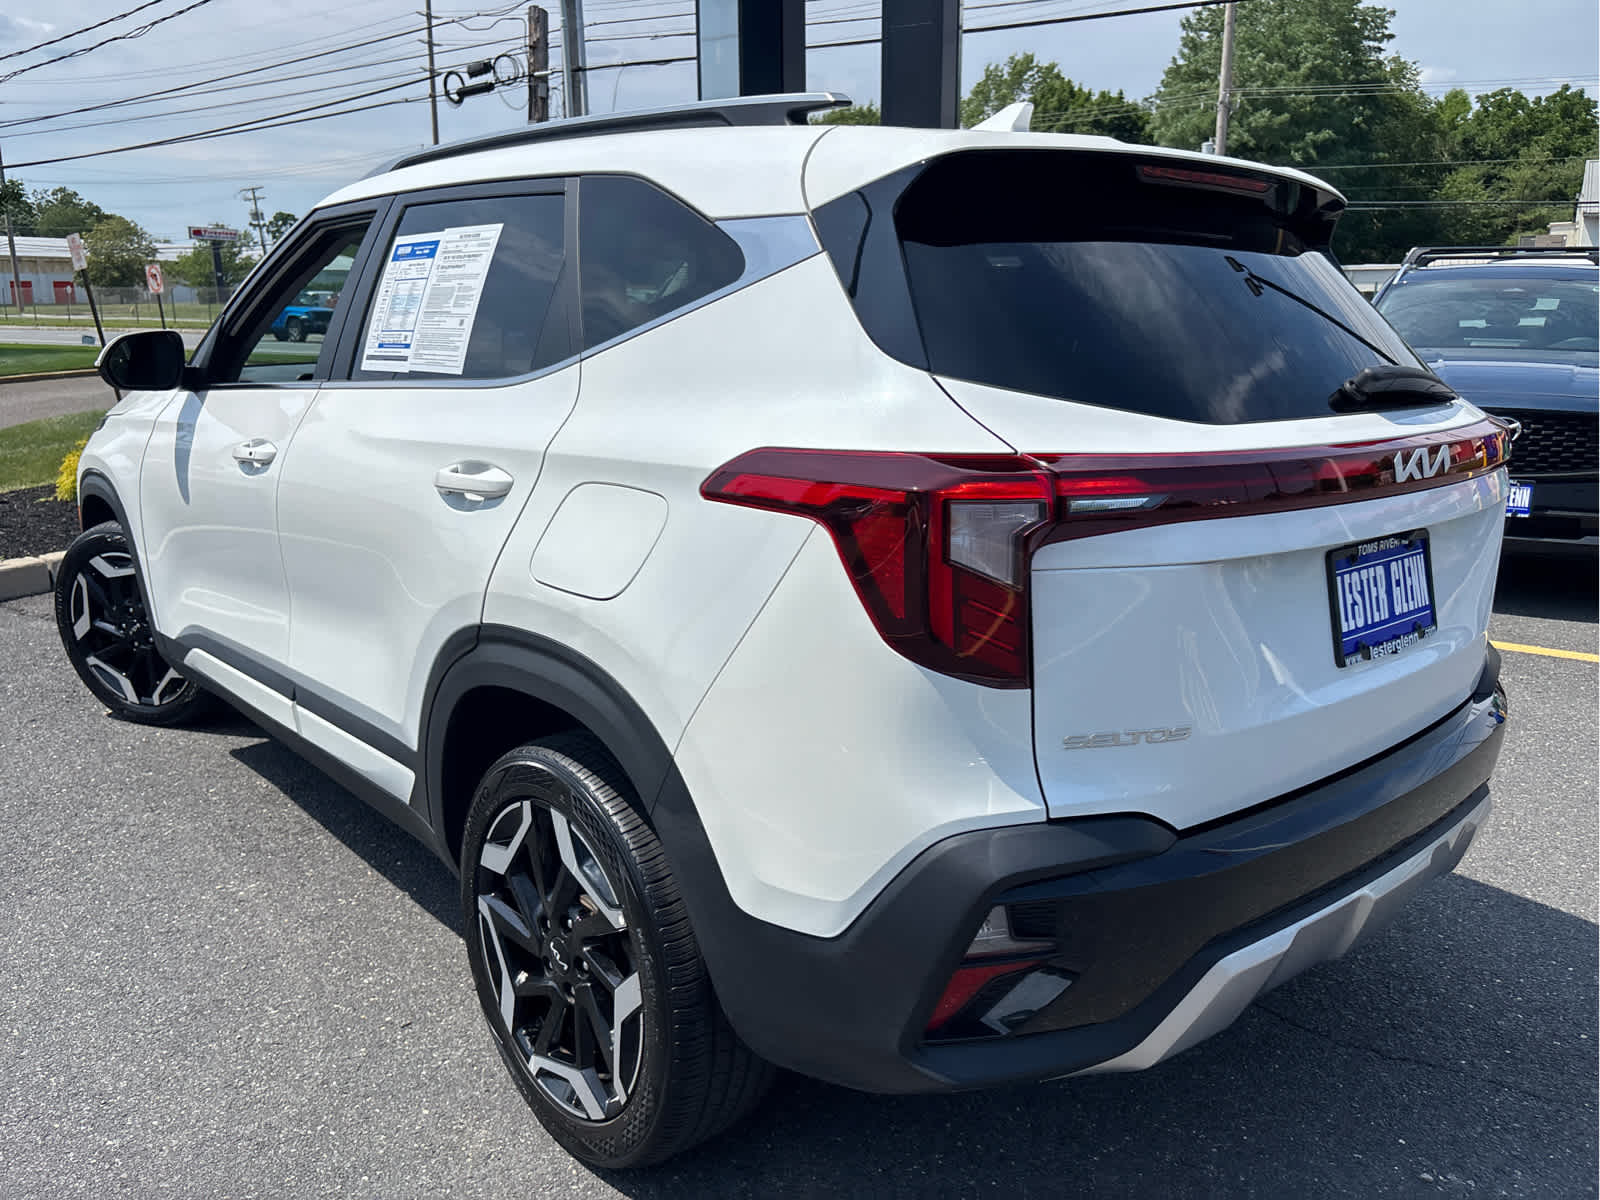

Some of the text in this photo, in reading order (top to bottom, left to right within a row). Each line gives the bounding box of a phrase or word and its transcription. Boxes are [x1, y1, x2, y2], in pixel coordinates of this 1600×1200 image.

[1394, 444, 1451, 484] KIA
[1508, 487, 1531, 508] ENN
[1336, 553, 1430, 633] LESTER GLENN
[1063, 726, 1192, 750] SELTOS
